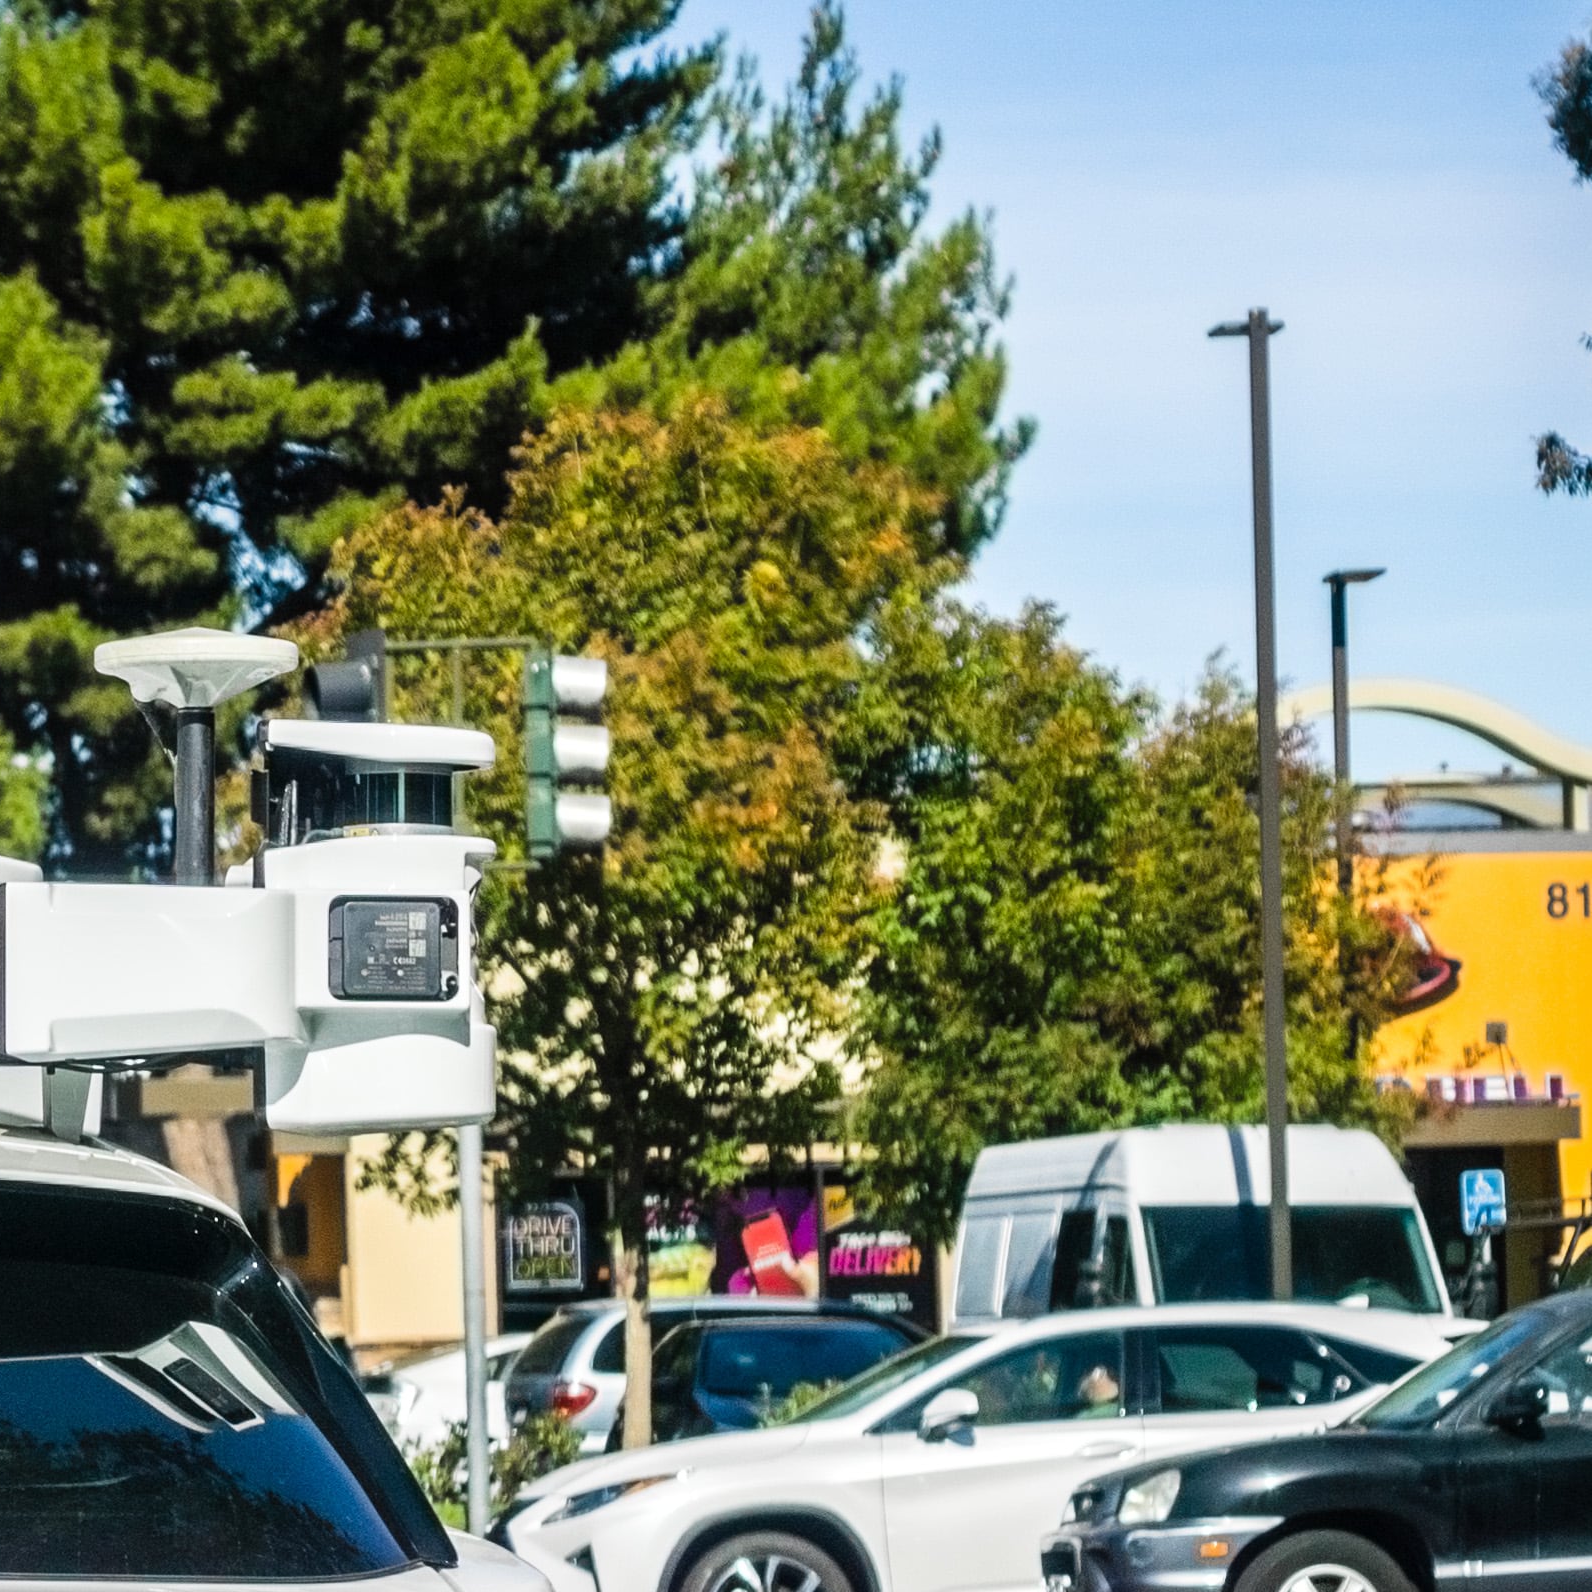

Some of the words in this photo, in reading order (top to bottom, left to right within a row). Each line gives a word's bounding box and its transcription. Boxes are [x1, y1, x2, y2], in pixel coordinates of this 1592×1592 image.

[1547, 882, 1590, 918] 81
[514, 1213, 575, 1236] DRIVE
[516, 1235, 575, 1257] THRU
[516, 1257, 576, 1278] OPEN
[828, 1245, 921, 1275] DELIVERY
